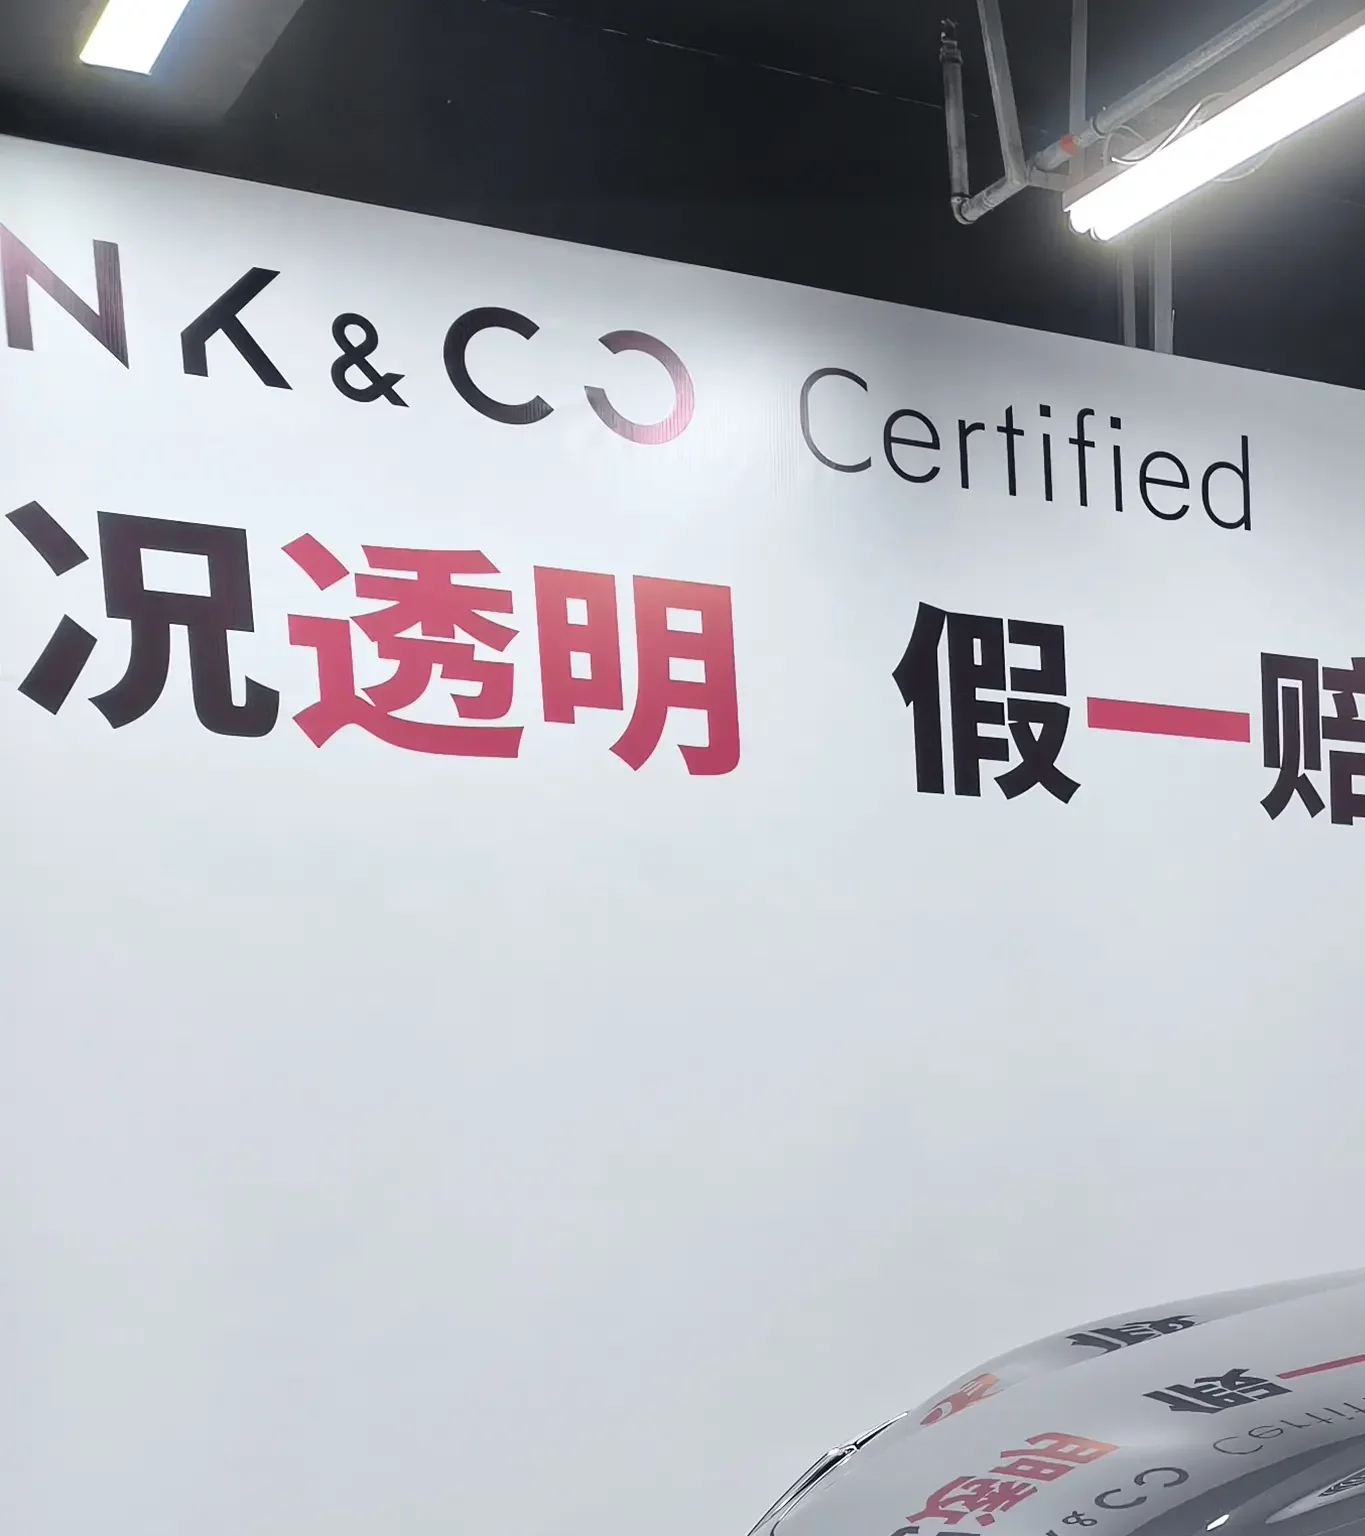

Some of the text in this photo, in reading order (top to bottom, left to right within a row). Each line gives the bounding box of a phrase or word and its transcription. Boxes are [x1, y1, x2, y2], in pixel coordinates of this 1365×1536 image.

[798, 367, 1252, 532] Certified
[4, 500, 741, 777] 况透明
